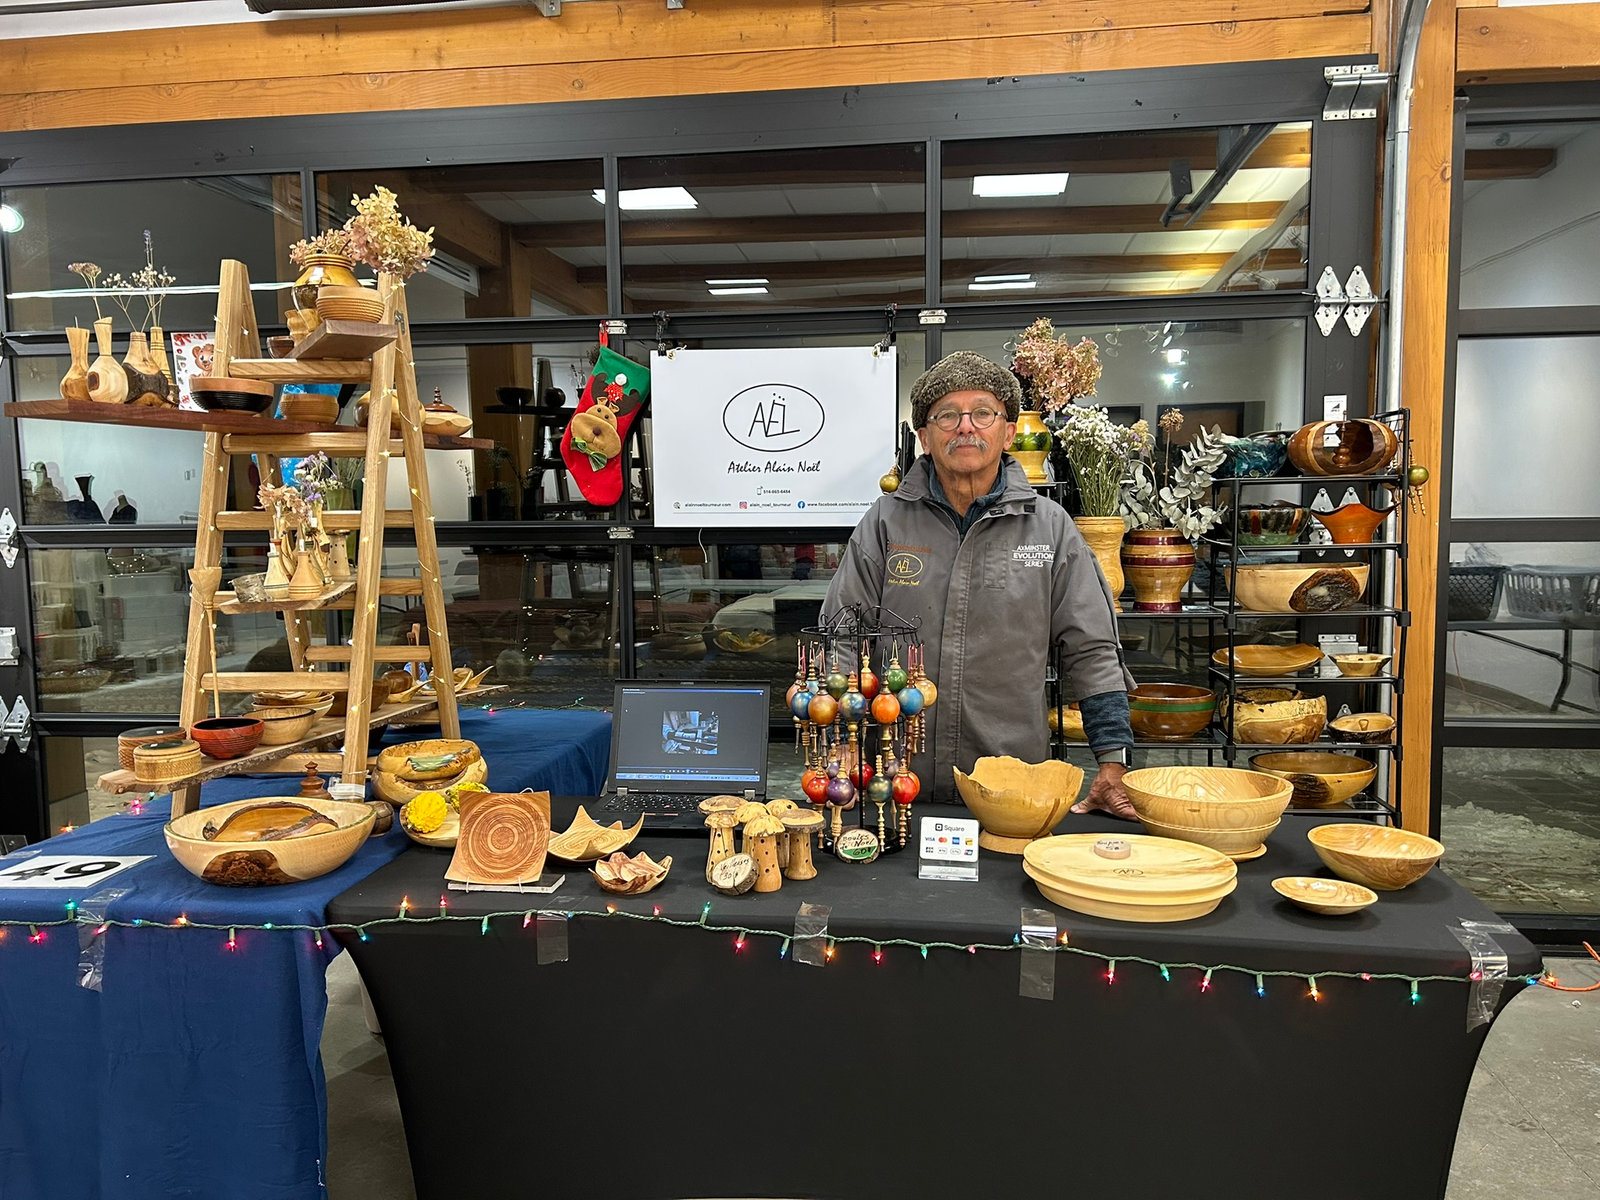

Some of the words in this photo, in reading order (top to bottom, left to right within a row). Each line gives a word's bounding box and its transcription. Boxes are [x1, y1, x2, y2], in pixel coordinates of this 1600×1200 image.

[727, 460, 761, 474] Atelier
[764, 460, 794, 474] Alain
[797, 460, 821, 473] Noël
[1013, 552, 1054, 560] EVOLUTION
[944, 824, 965, 832] Square
[0, 861, 121, 881] 49
